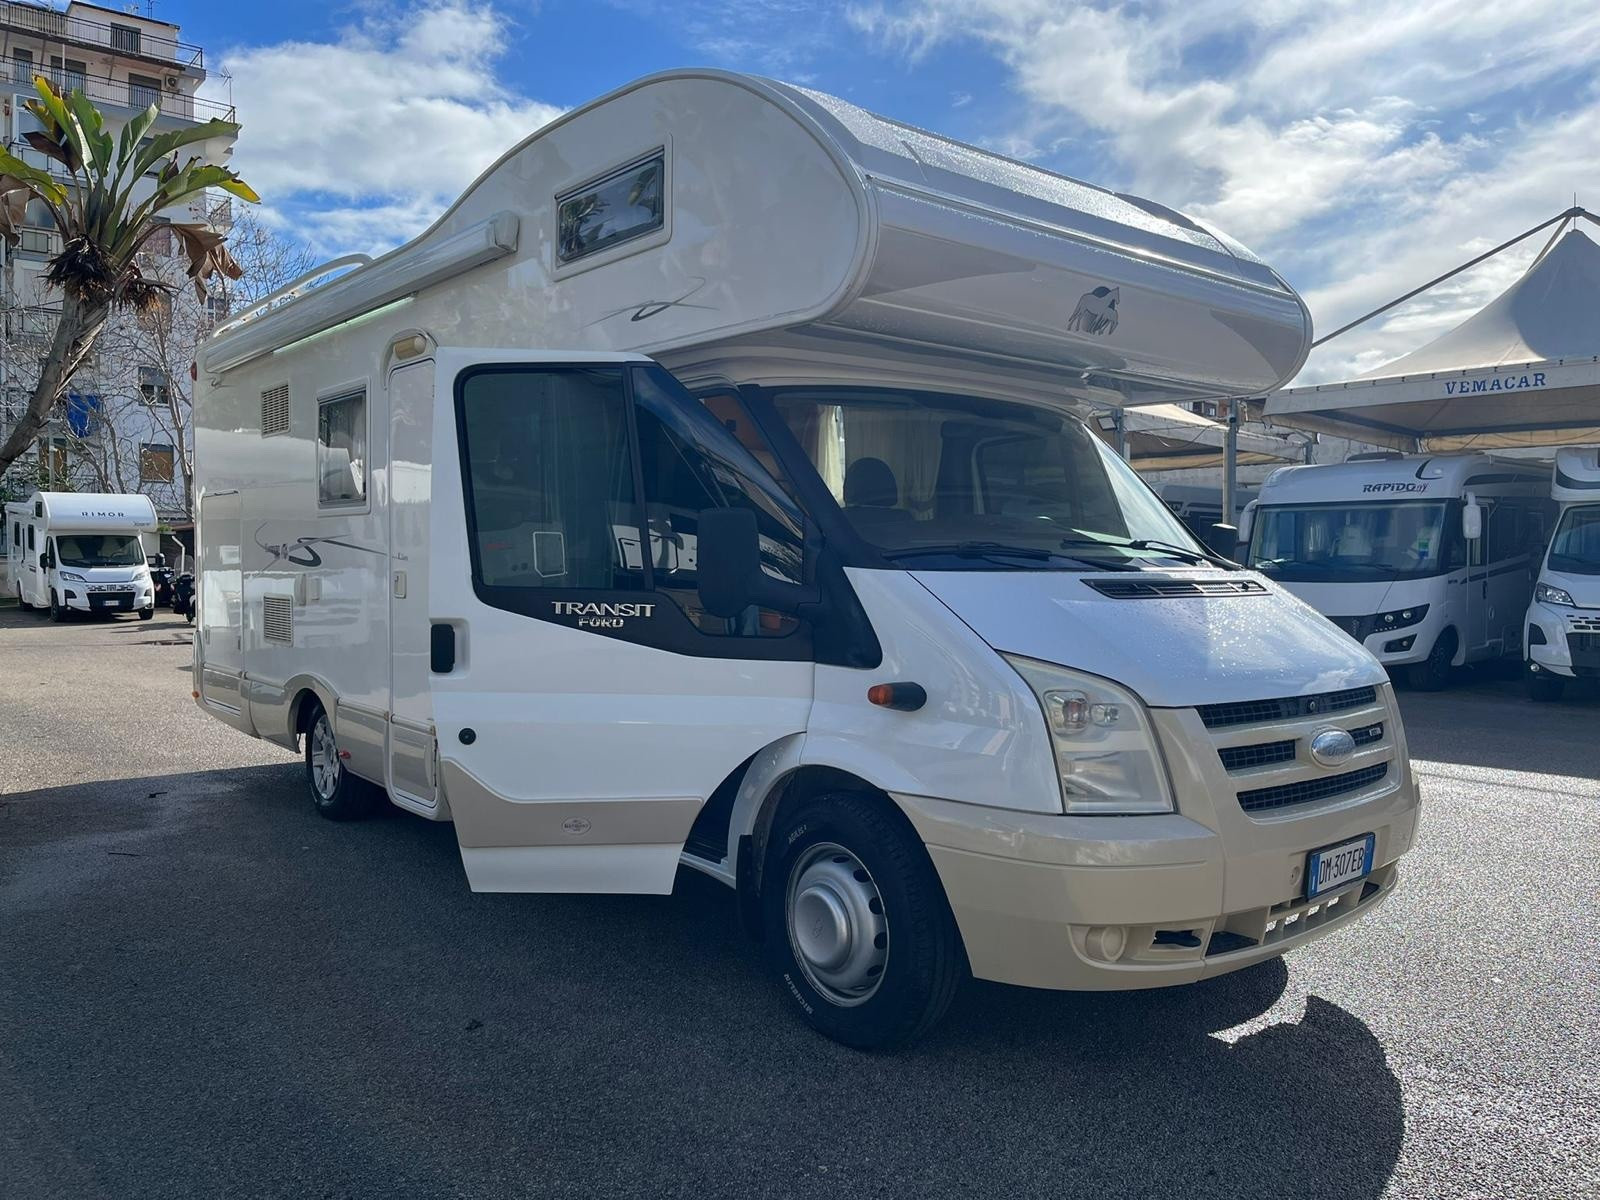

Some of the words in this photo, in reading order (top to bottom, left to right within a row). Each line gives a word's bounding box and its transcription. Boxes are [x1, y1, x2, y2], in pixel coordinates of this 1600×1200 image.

[1444, 373, 1546, 394] VEMACAR
[551, 601, 656, 617] TRANSIT
[578, 617, 624, 628] FORD
